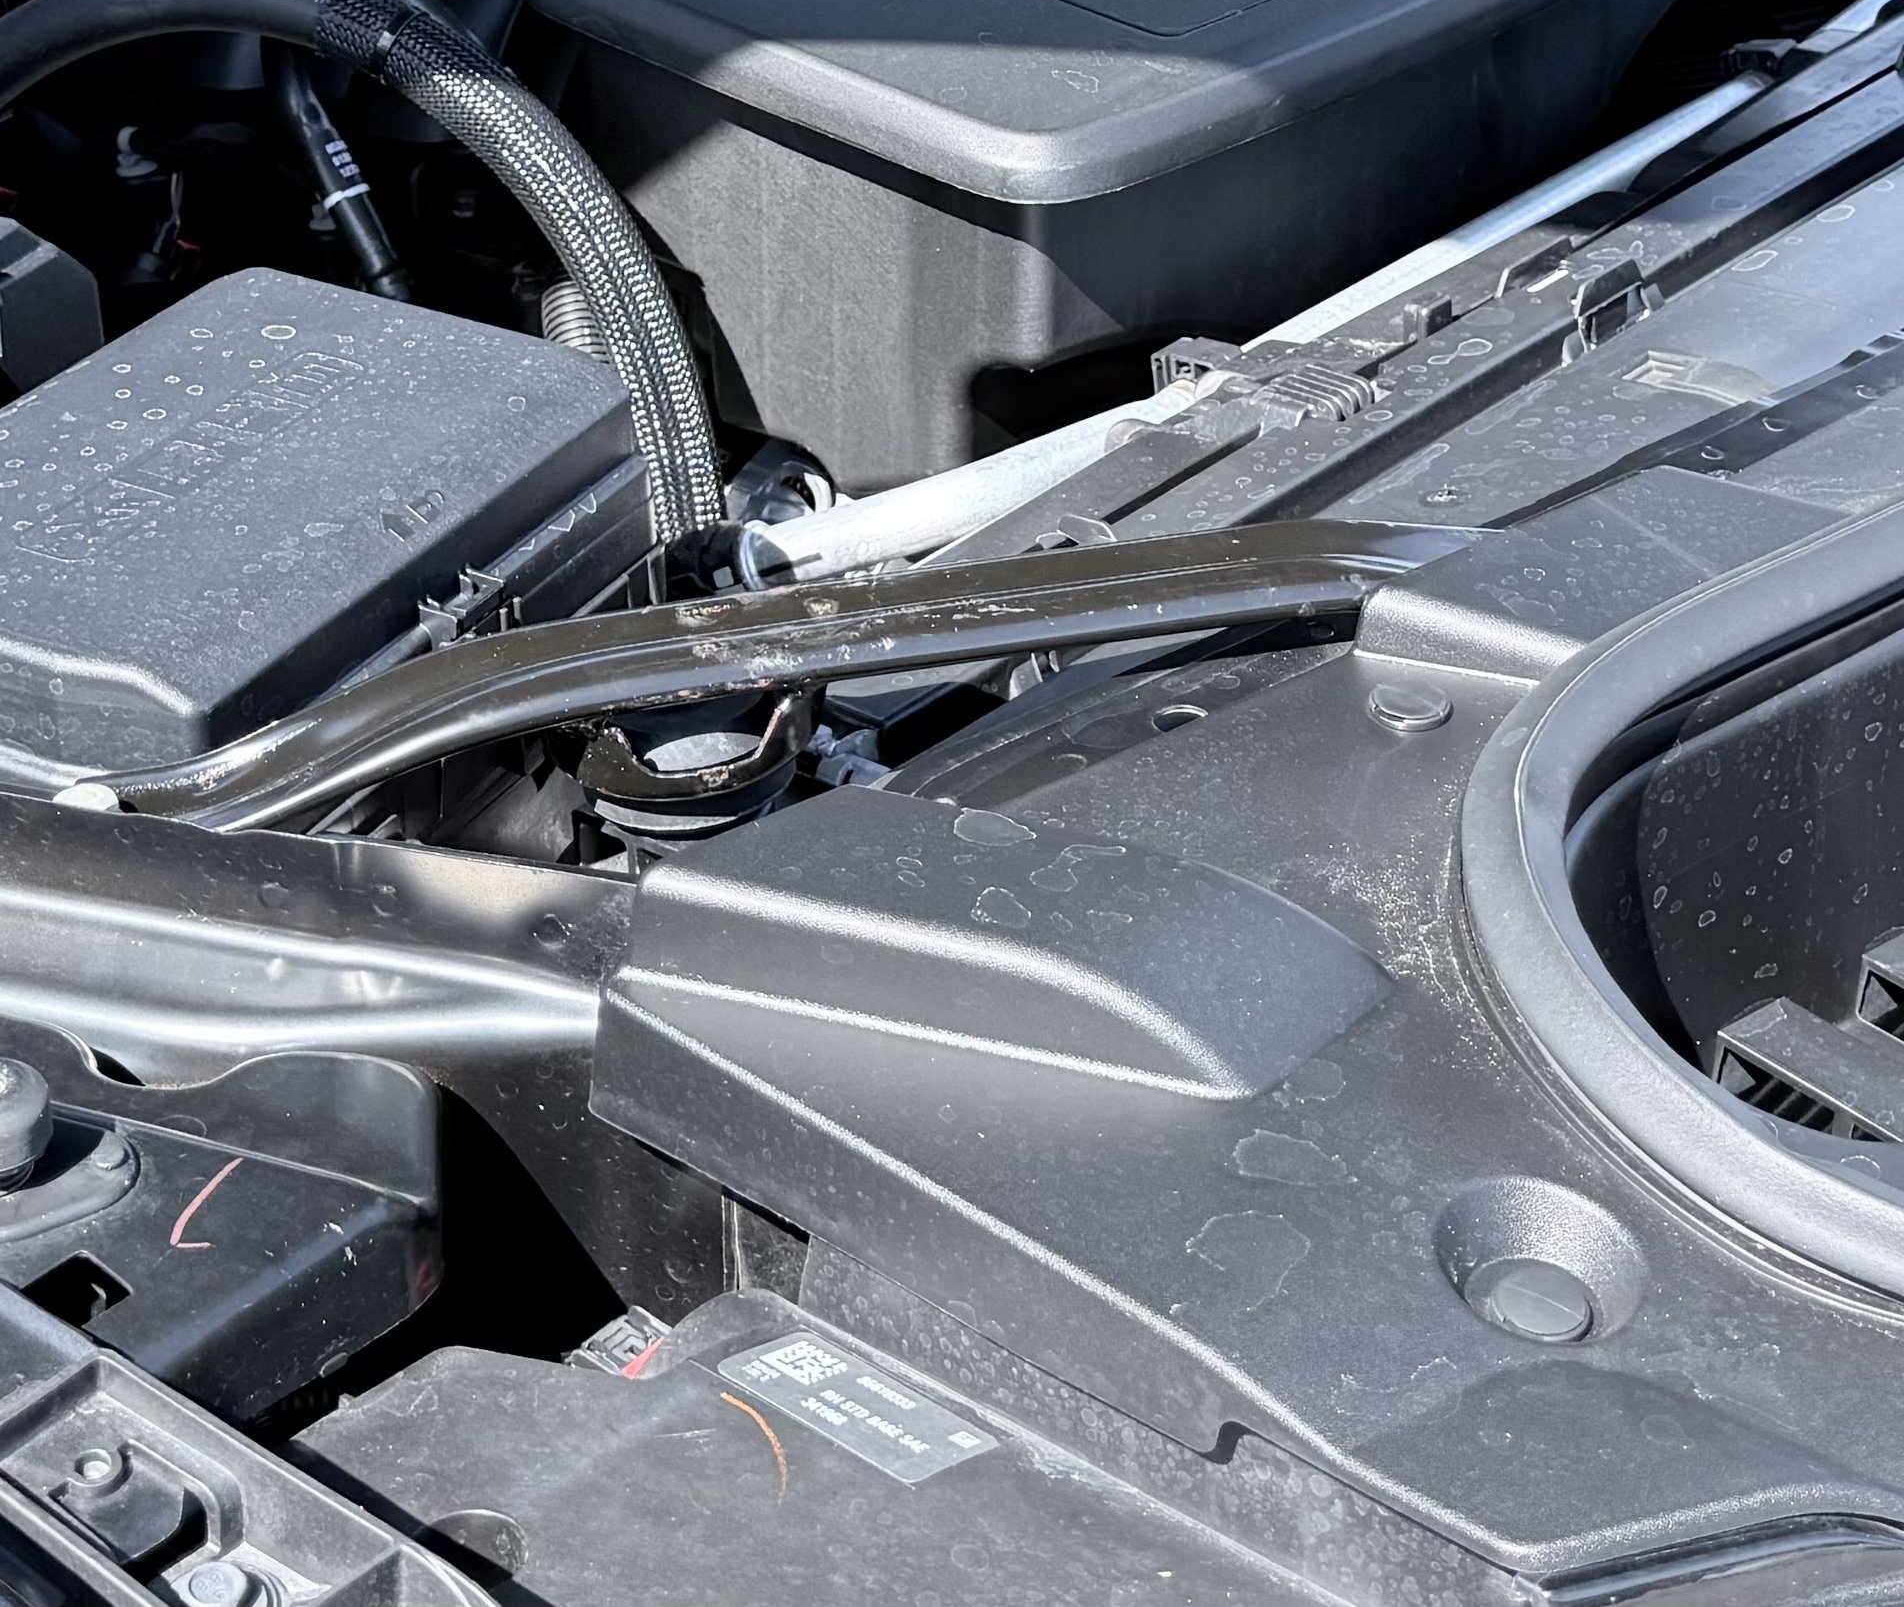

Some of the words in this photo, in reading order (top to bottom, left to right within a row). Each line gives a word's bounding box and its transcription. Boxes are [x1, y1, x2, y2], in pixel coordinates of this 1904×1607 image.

[819, 1389, 847, 1405] RH
[840, 1400, 870, 1419] STD
[865, 1415, 904, 1438] BASE
[898, 1434, 930, 1454] SAE
